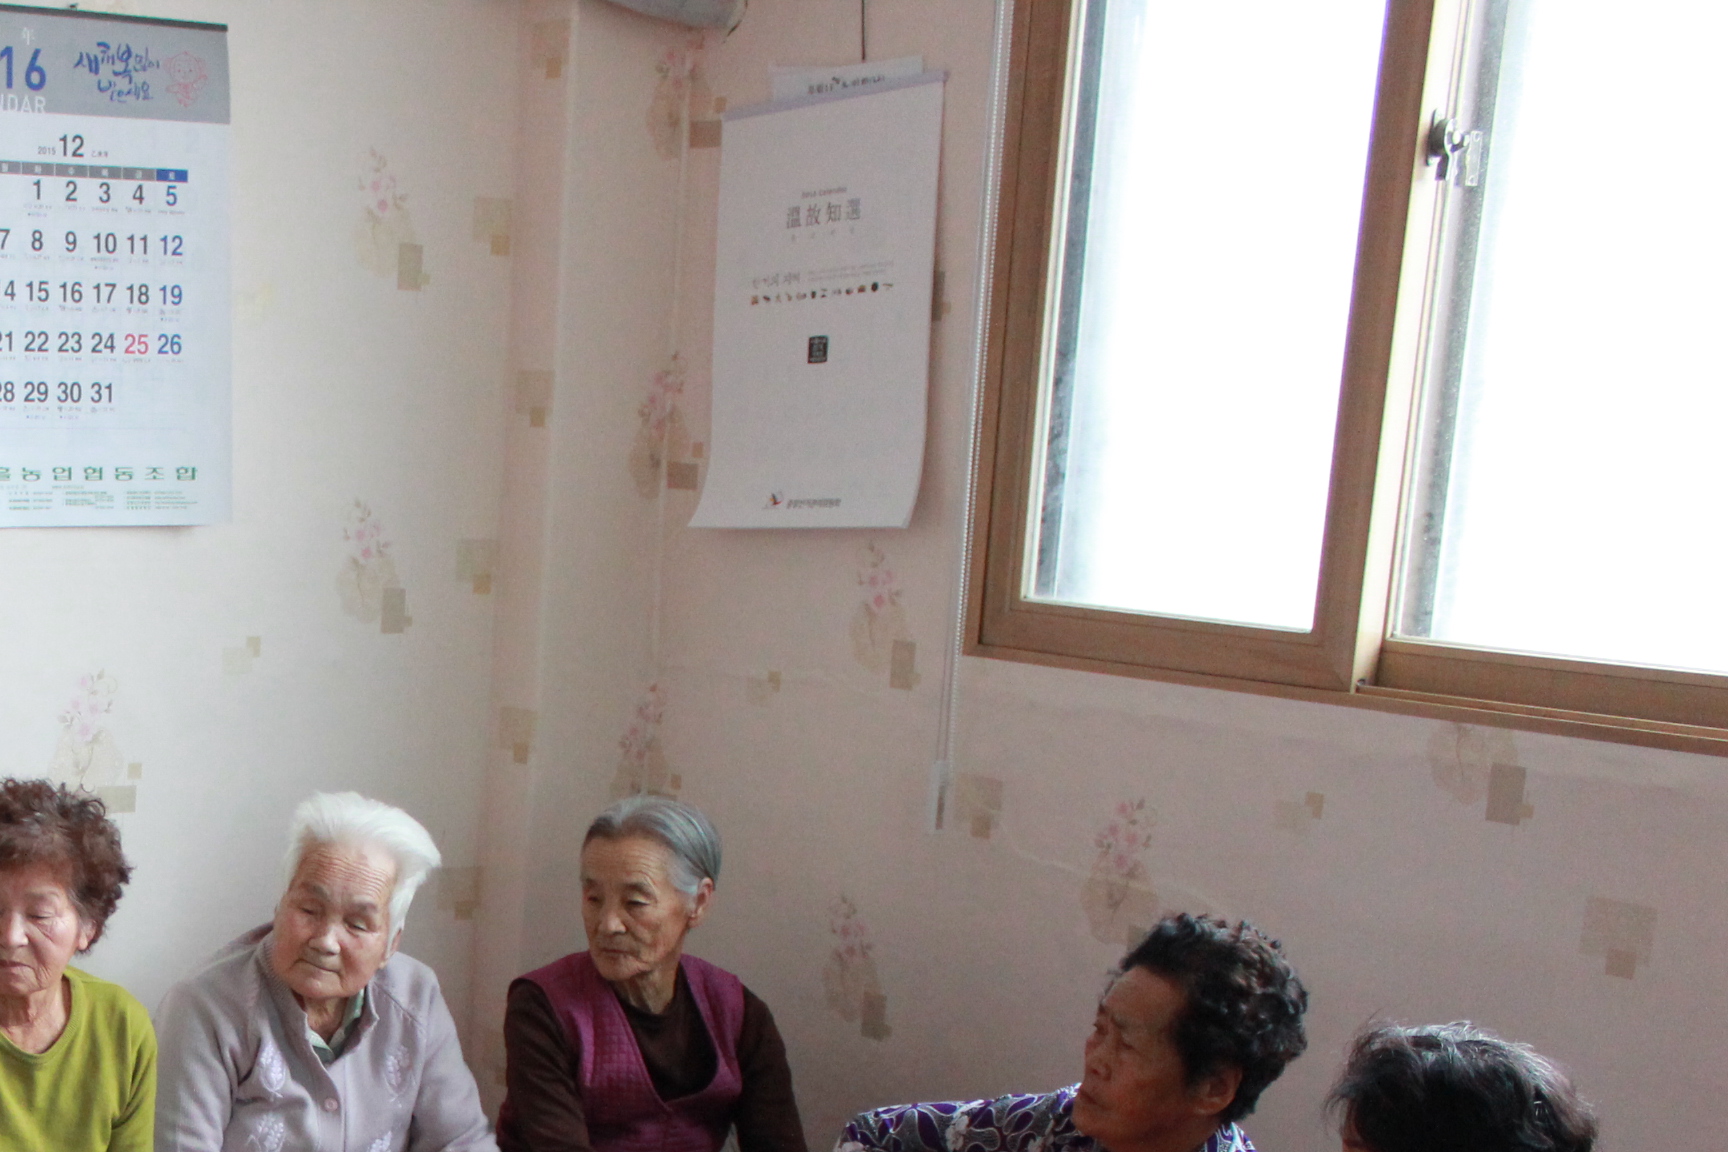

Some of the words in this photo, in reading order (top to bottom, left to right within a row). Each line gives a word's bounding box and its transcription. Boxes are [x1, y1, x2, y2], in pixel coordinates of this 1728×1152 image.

[38, 146, 56, 156] 2015
[59, 134, 84, 157] 12
[33, 179, 41, 200] 1
[65, 179, 77, 202] 2
[99, 182, 111, 204] 3
[133, 184, 145, 205] 4
[166, 185, 177, 207] 5
[31, 229, 43, 251] 8
[65, 230, 77, 253] 9
[93, 232, 117, 255] 10
[127, 233, 148, 255] 11
[160, 235, 183, 257] 12
[25, 280, 50, 303] 15
[59, 281, 83, 303] 16
[93, 282, 117, 304] 17
[126, 283, 149, 305] 18
[159, 284, 183, 306] 19
[24, 330, 49, 352] 22
[57, 331, 82, 353] 23
[91, 332, 116, 354] 24
[124, 333, 149, 355] 25
[157, 333, 182, 355] 26
[23, 381, 48, 403] 29
[57, 381, 82, 403] 30
[90, 382, 112, 403] 31
